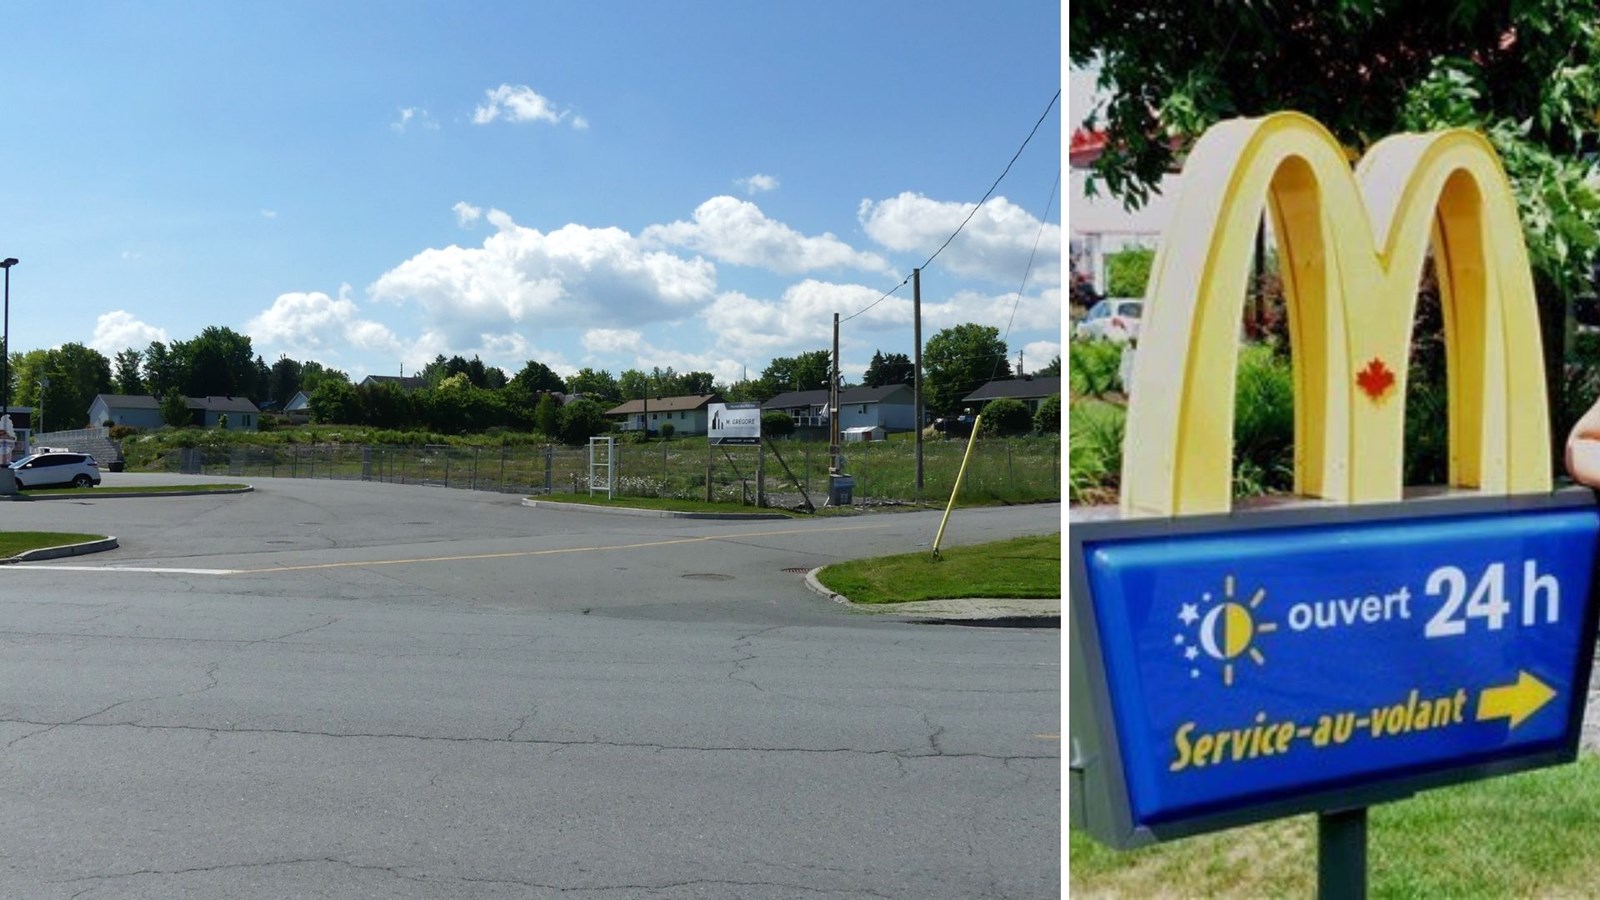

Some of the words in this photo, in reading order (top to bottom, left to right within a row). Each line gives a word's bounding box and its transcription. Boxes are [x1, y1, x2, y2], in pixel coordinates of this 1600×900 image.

[1288, 586, 1412, 632] ouvert
[1424, 563, 1511, 638] 24
[1523, 559, 1560, 626] h
[1170, 689, 1466, 772] Service-au-volant
